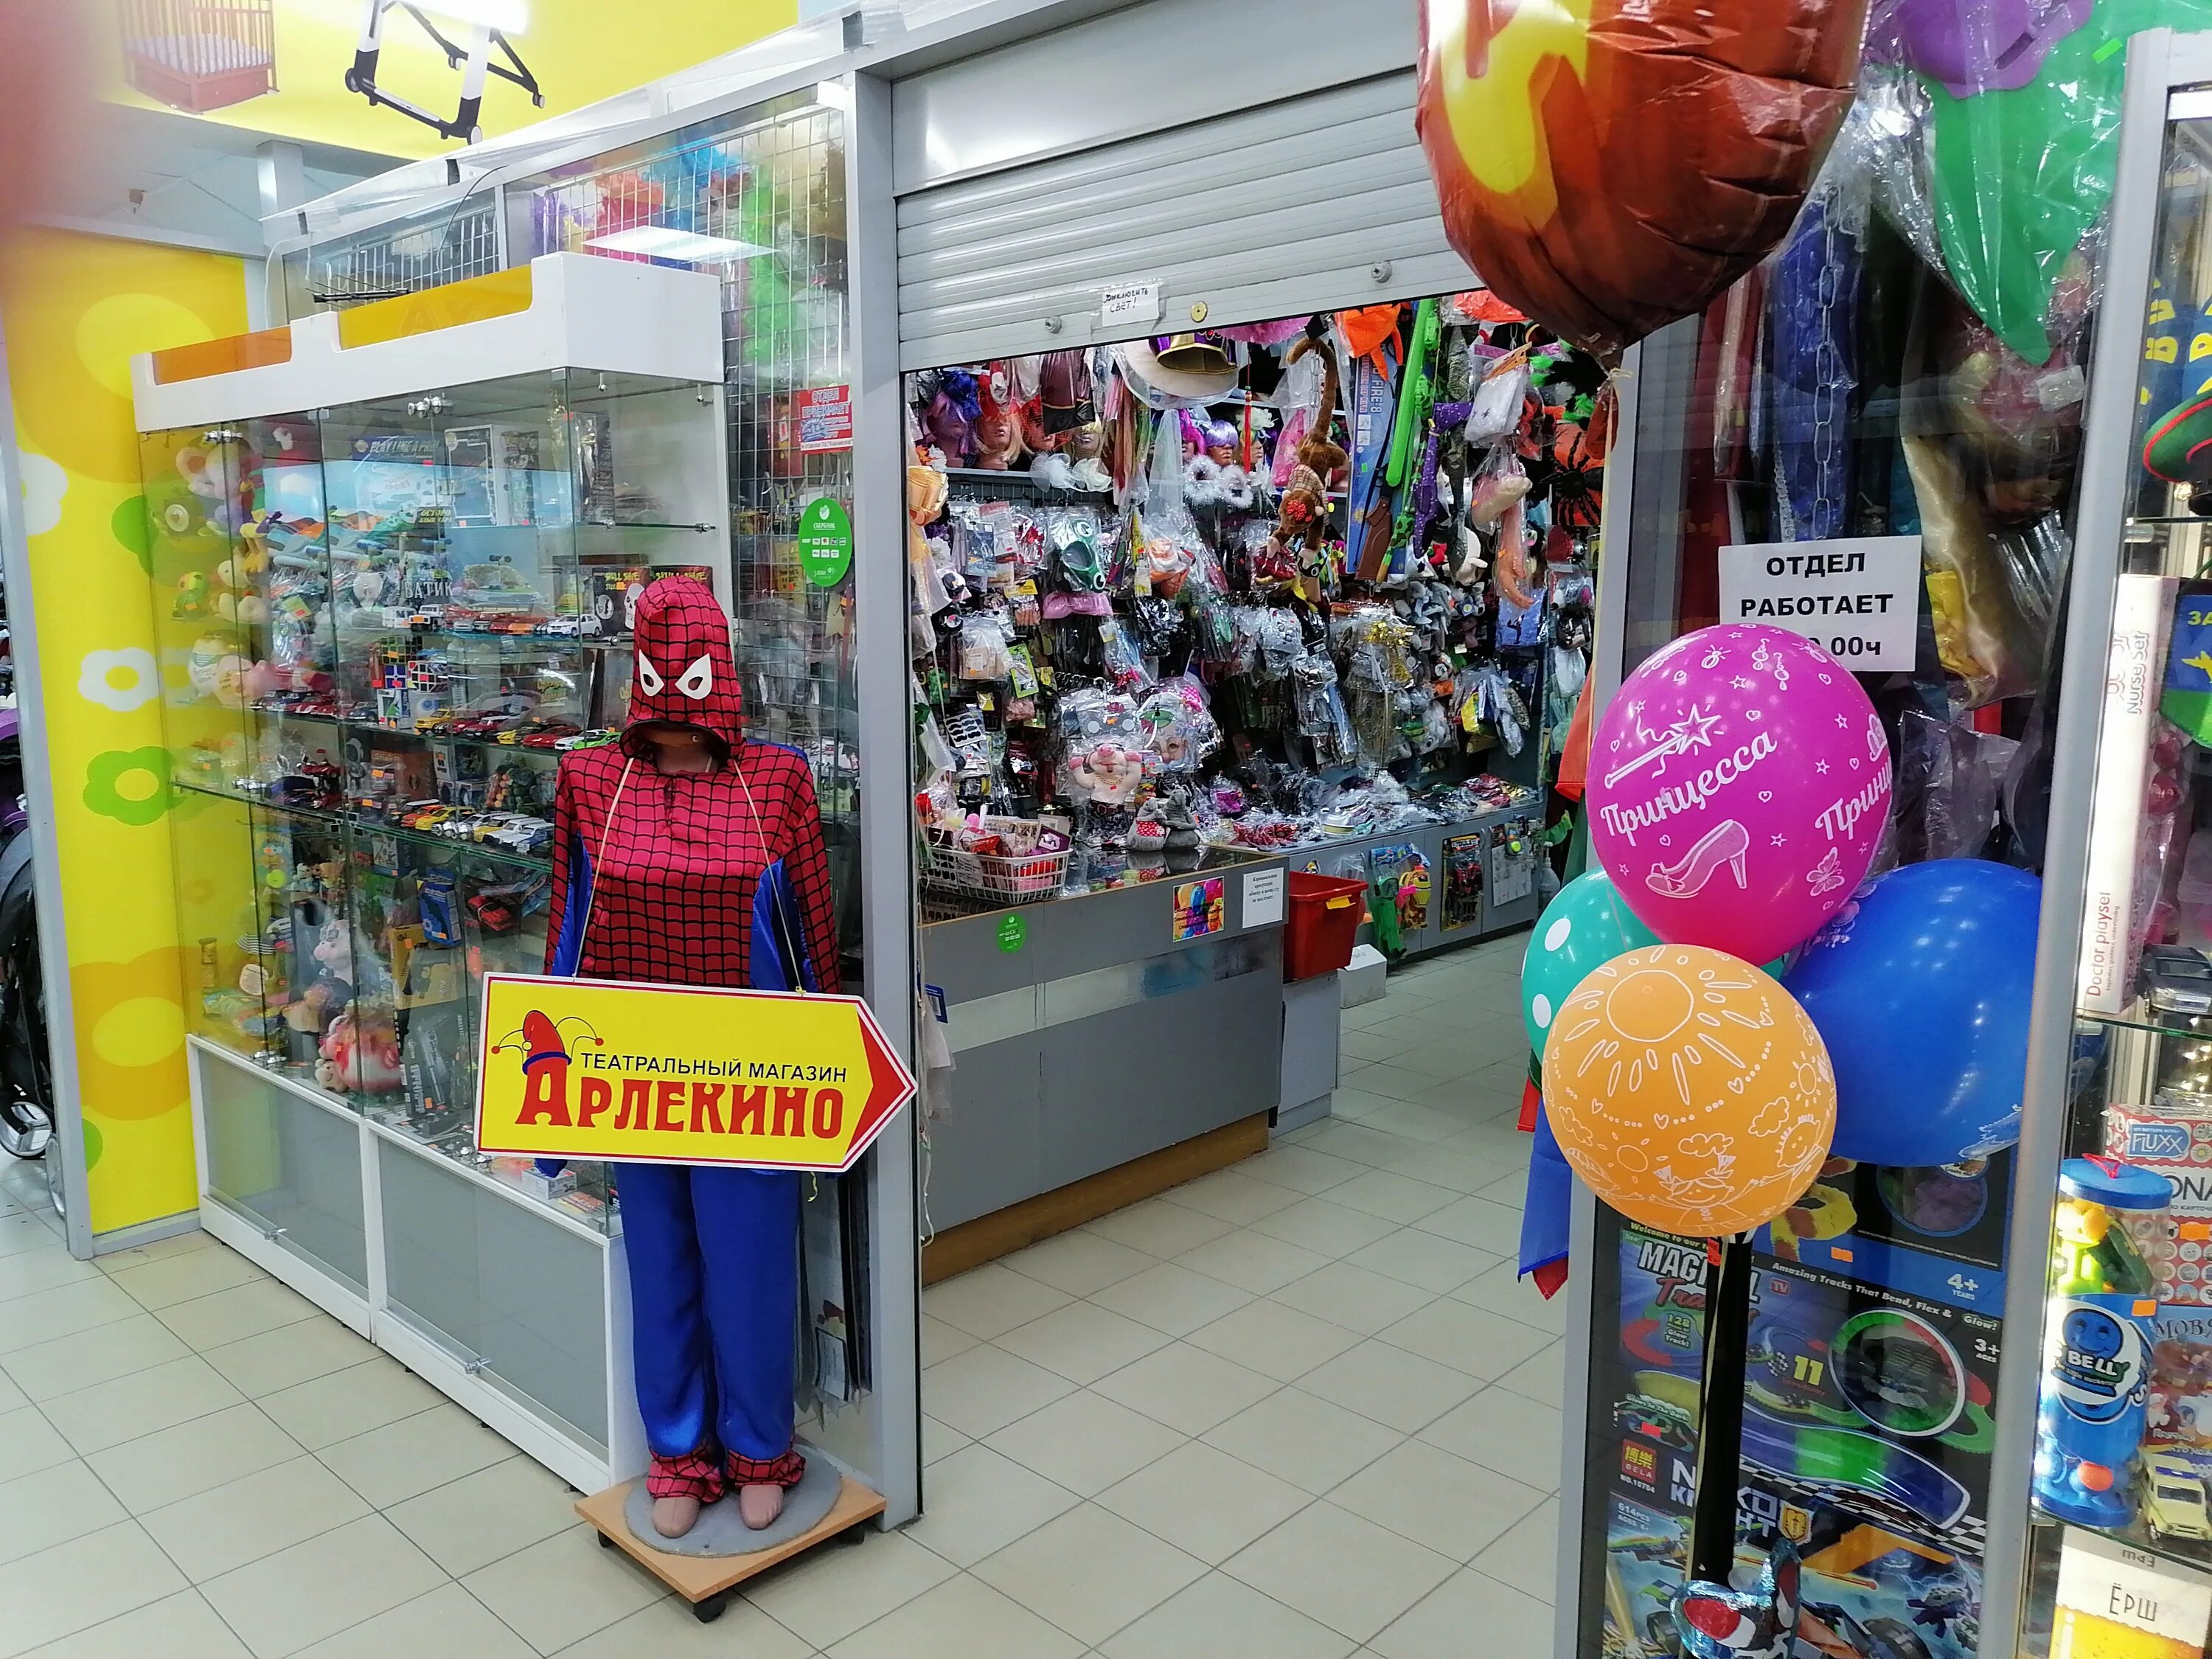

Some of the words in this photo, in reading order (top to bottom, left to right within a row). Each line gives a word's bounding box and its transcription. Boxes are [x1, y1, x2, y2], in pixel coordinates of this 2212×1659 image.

[812, 387, 840, 403] ОТДЕЛ
[1766, 552, 1865, 578] ОТДЕЛ
[404, 581, 453, 599] БАТИК
[1741, 594, 1893, 617] РАБОТАЕТ
[1600, 731, 1778, 846] Принцесса
[1815, 755, 1893, 841] Принц
[2086, 947, 2106, 997] Doctor
[2096, 891, 2113, 945] playset
[580, 1052, 742, 1077] ТЕАТРАЛЬНЫЙ
[749, 1063, 847, 1082] МАГАЗИН
[2132, 1133, 2184, 1153] FLUXX
[1630, 1222, 1670, 1239] Welcome
[1672, 1234, 1682, 1242] to
[1683, 1239, 1700, 1248] our
[1772, 1262, 1817, 1282] Amazing
[1819, 1274, 1852, 1291] Tracks
[1855, 1284, 1879, 1298] That
[1882, 1293, 1913, 1310] Bend,
[1916, 1302, 1940, 1315] Flex
[1942, 1308, 1952, 1318] &
[1947, 1273, 1979, 1292] 4+
[1668, 1314, 1691, 1328] 128
[1964, 1315, 1998, 1331] Glow!
[1974, 1338, 2000, 1355] 3+
[1975, 1352, 1997, 1363] AGES
[1793, 1354, 1825, 1386] 11
[2067, 1349, 2131, 1383] BELLY
[1625, 1463, 1652, 1478] BELA
[2110, 1582, 2157, 1622] ЁРШ
